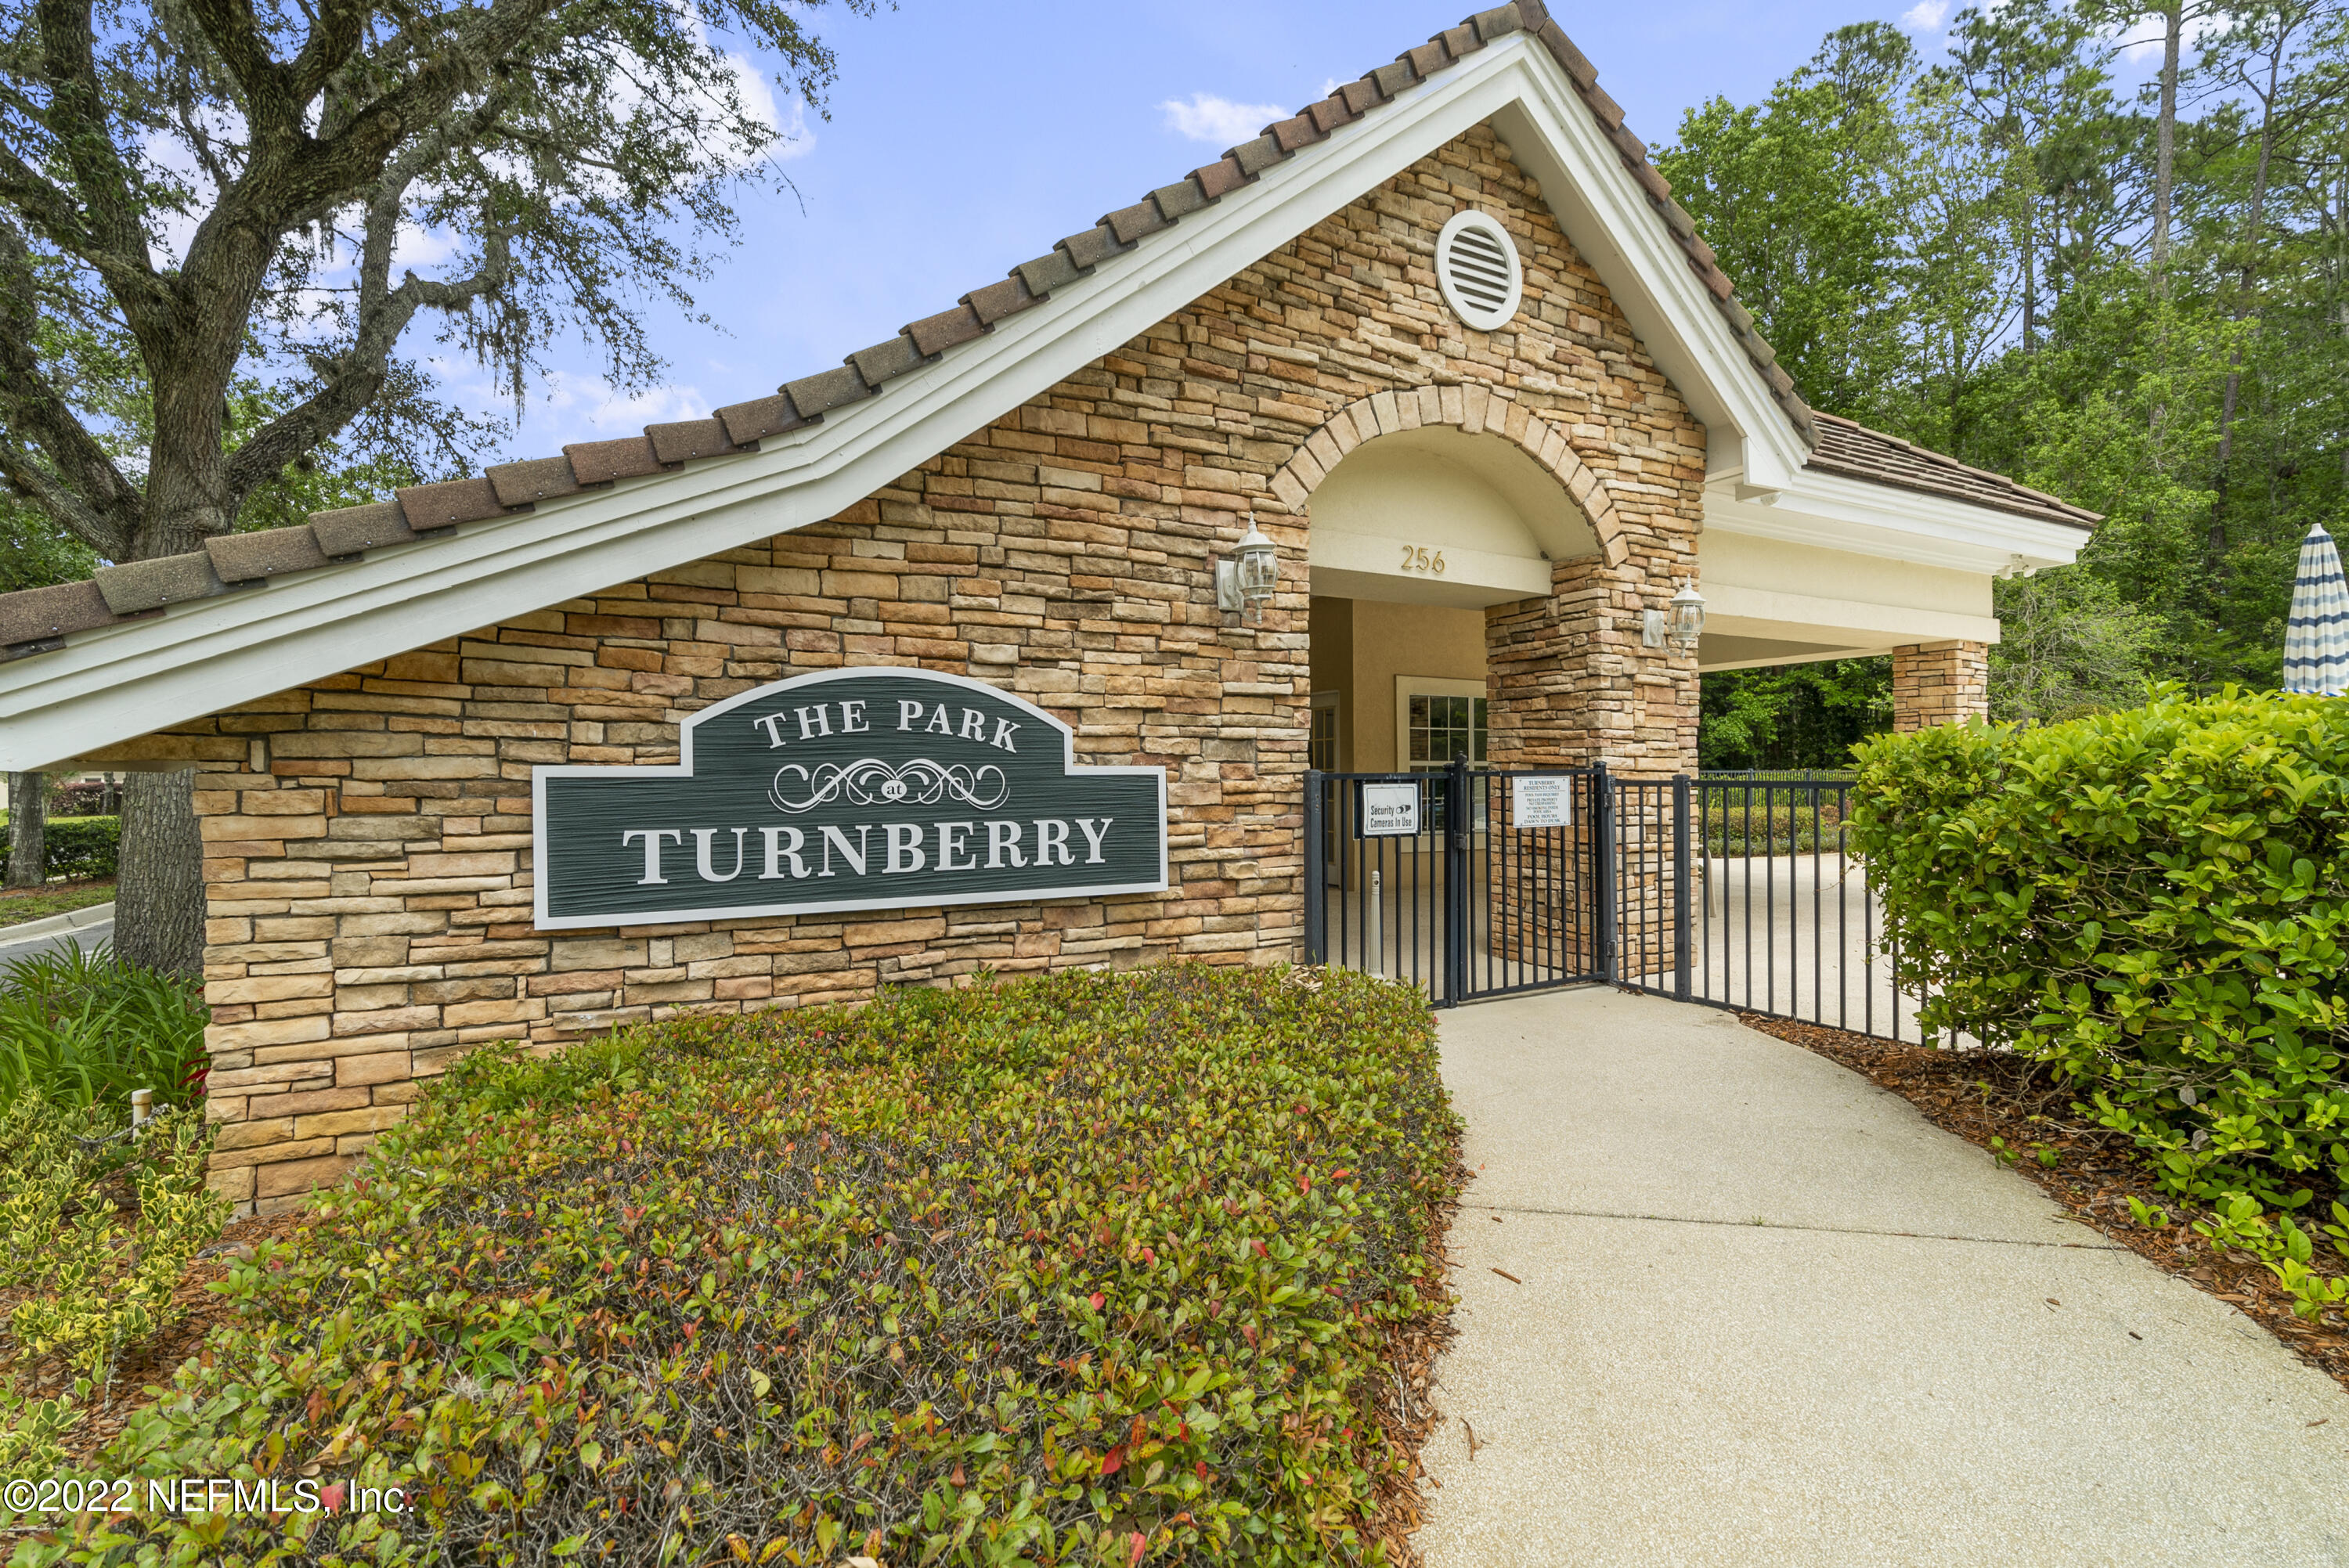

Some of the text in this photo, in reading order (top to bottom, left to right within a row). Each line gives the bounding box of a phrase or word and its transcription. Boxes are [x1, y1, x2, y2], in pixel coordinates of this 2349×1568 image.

[1401, 544, 1445, 573] 256
[753, 699, 1022, 754] THE PARK
[886, 783, 903, 797] at
[1370, 805, 1394, 816] Security
[1370, 816, 1412, 828] Cameras In Use
[622, 817, 1114, 885] TURNBERRY
